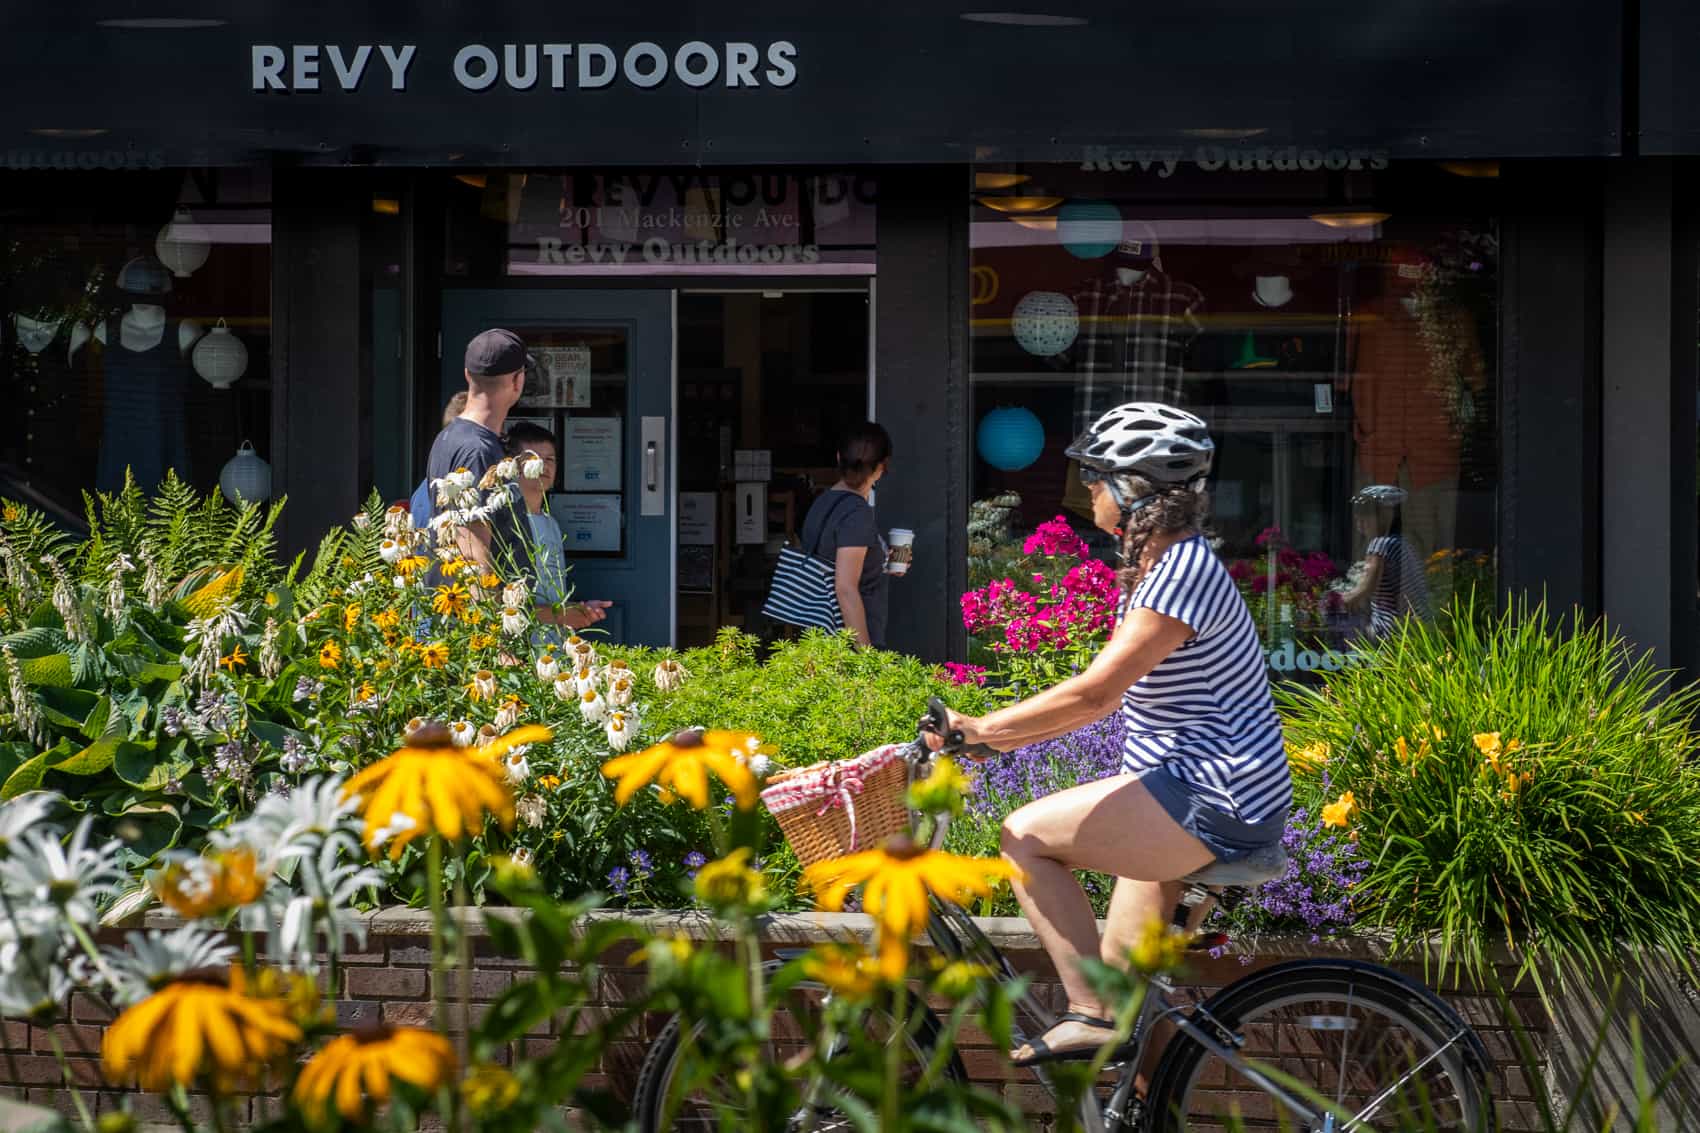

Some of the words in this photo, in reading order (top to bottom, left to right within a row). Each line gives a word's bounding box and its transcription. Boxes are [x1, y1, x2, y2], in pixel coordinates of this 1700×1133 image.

[251, 45, 417, 90] REVY
[452, 41, 798, 91] OUTDOORS
[1080, 145, 1183, 178] Revy
[1192, 145, 1389, 172] Outdoors
[559, 208, 603, 228] 201
[616, 207, 744, 228] Mackenzie
[753, 208, 801, 228] Ave.
[537, 236, 632, 268] Revy
[642, 236, 819, 264] Outdoors
